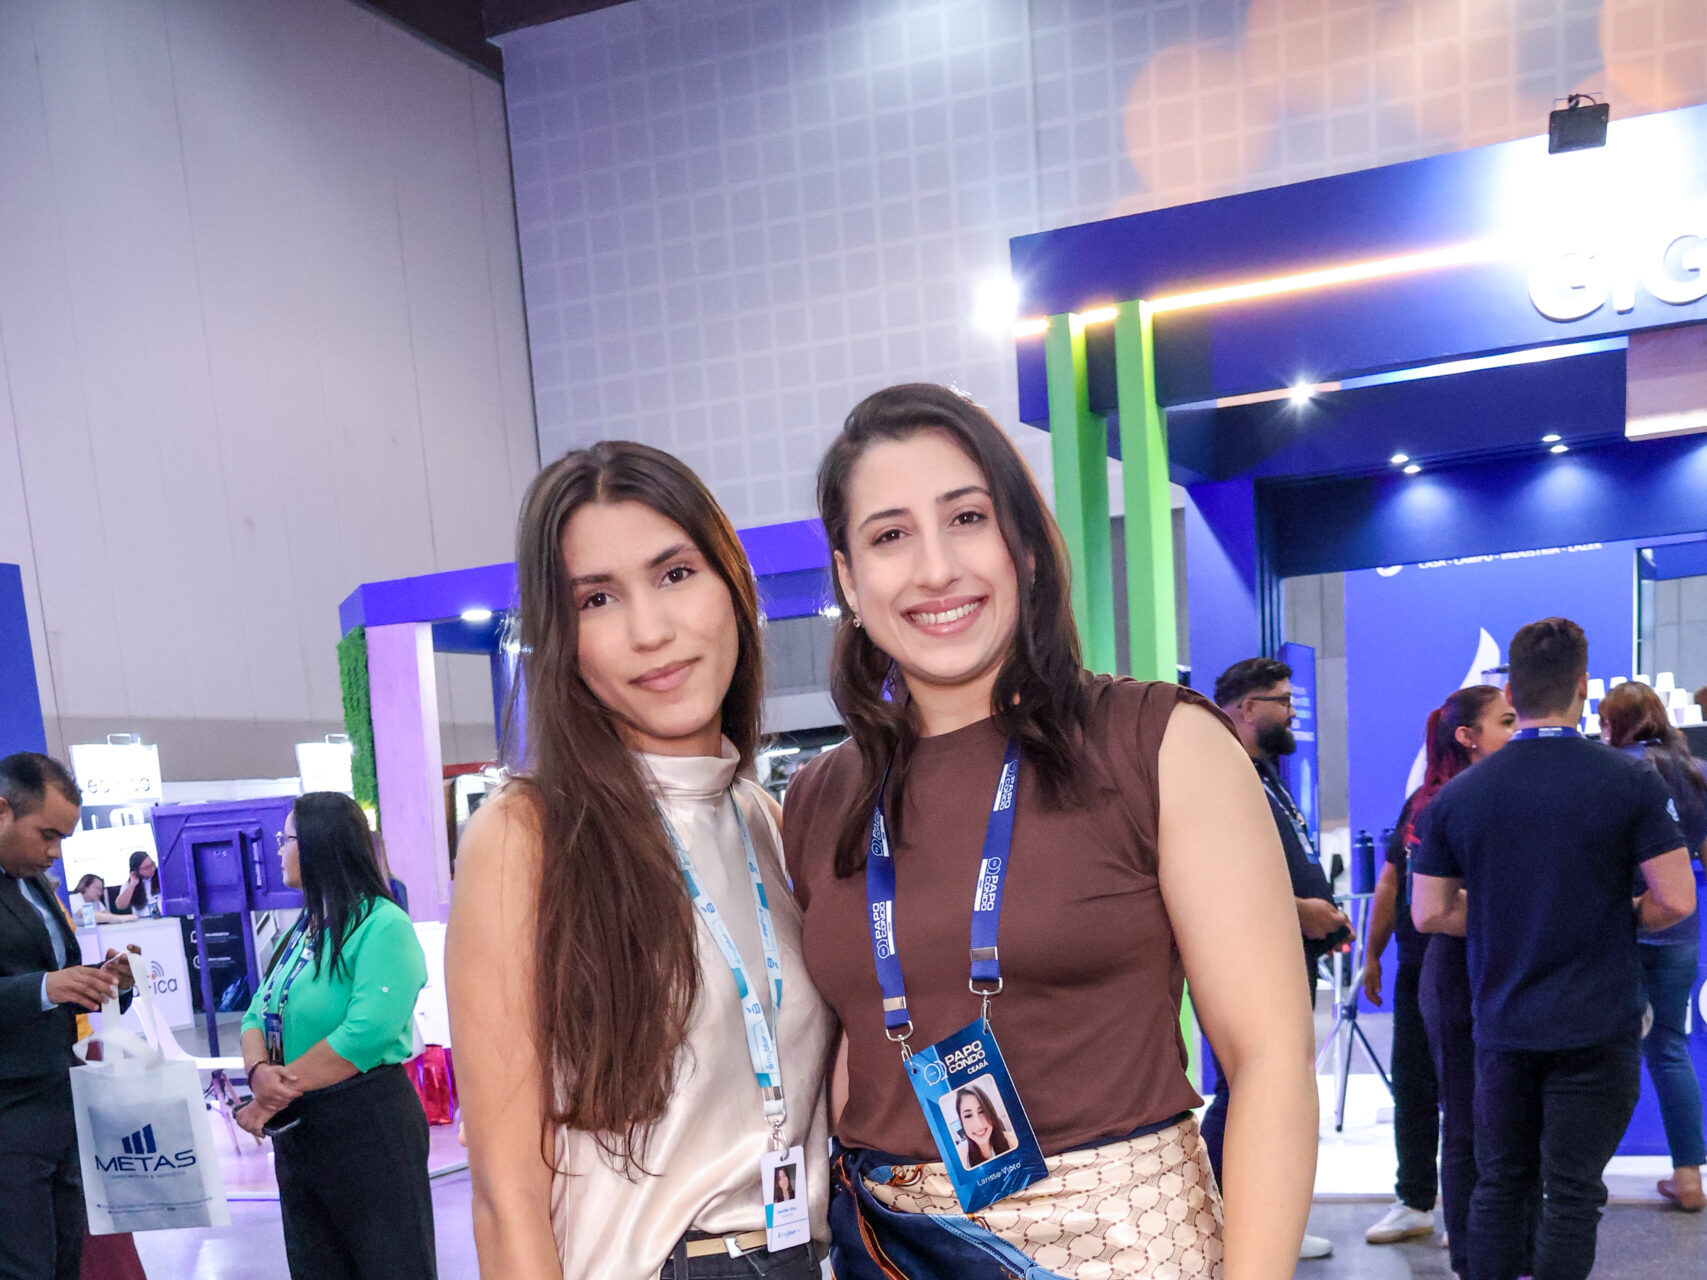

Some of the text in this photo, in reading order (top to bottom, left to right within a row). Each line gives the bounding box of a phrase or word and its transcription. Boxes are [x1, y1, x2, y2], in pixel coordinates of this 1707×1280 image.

[999, 779, 1010, 810] CONDO
[1004, 776, 1015, 809] PAPO
[980, 875, 992, 911] CONDO
[986, 875, 999, 911] PAPO
[872, 902, 881, 939] PAPO
[879, 901, 887, 937] CONDO
[944, 1040, 982, 1066] PAPO
[948, 1050, 986, 1074] CONDO
[967, 1060, 989, 1075] CEARÁ
[95, 1149, 196, 1172] METAS
